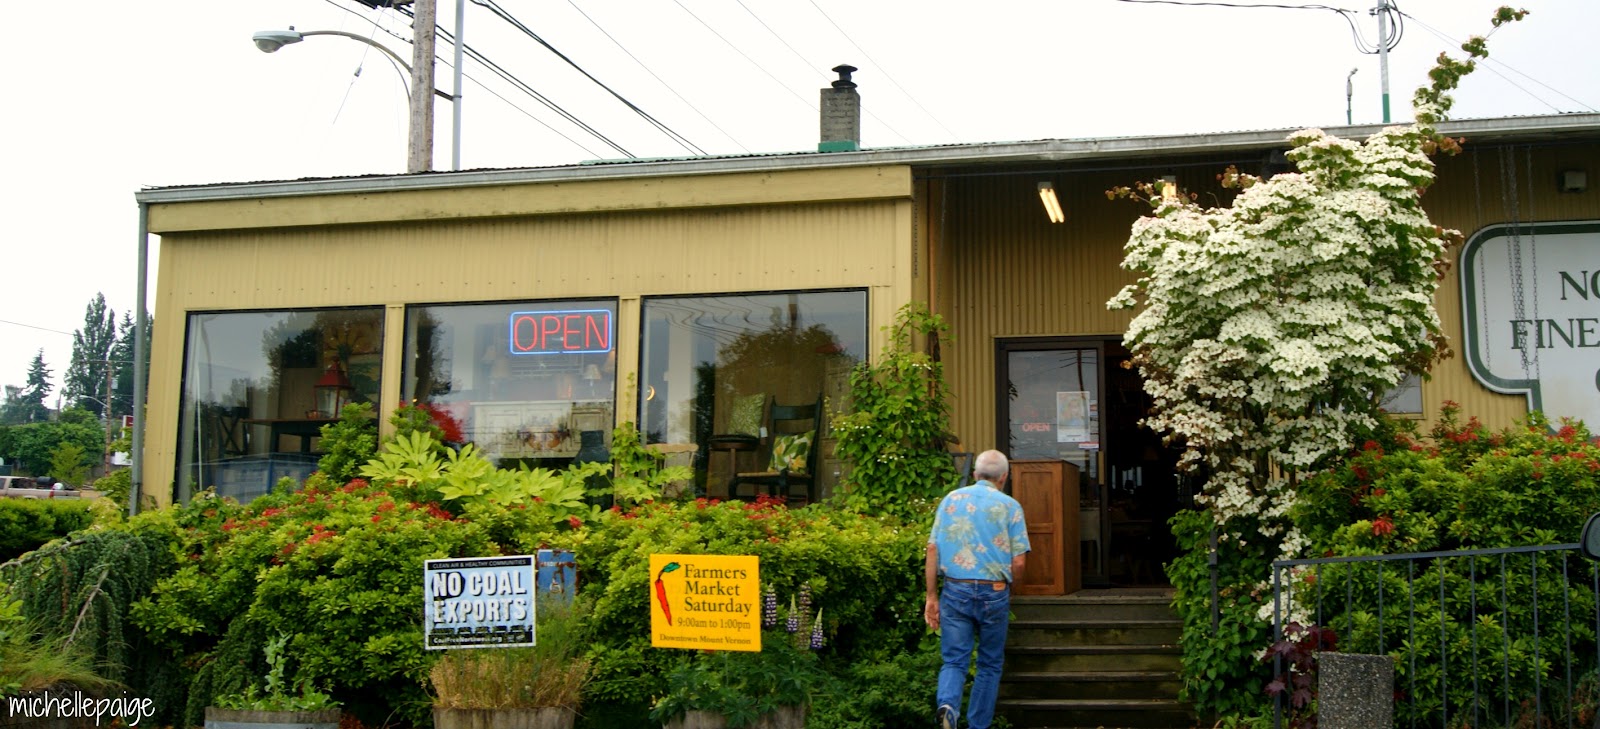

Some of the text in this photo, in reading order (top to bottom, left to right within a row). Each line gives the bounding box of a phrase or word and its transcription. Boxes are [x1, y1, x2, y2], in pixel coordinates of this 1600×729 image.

[513, 314, 608, 351] OPEN
[1509, 318, 1600, 350] FINE
[1022, 422, 1051, 432] OPEN
[489, 559, 527, 567] COMMUNITIES
[684, 564, 747, 579] Farmers
[433, 570, 527, 597] NO COAL
[684, 581, 740, 596] Market
[433, 597, 527, 624] EXPORTS
[684, 597, 752, 617] Saturday
[677, 617, 751, 632] 9:00am to 1:00pm
[660, 634, 751, 645] Downtown Mount Vernon
